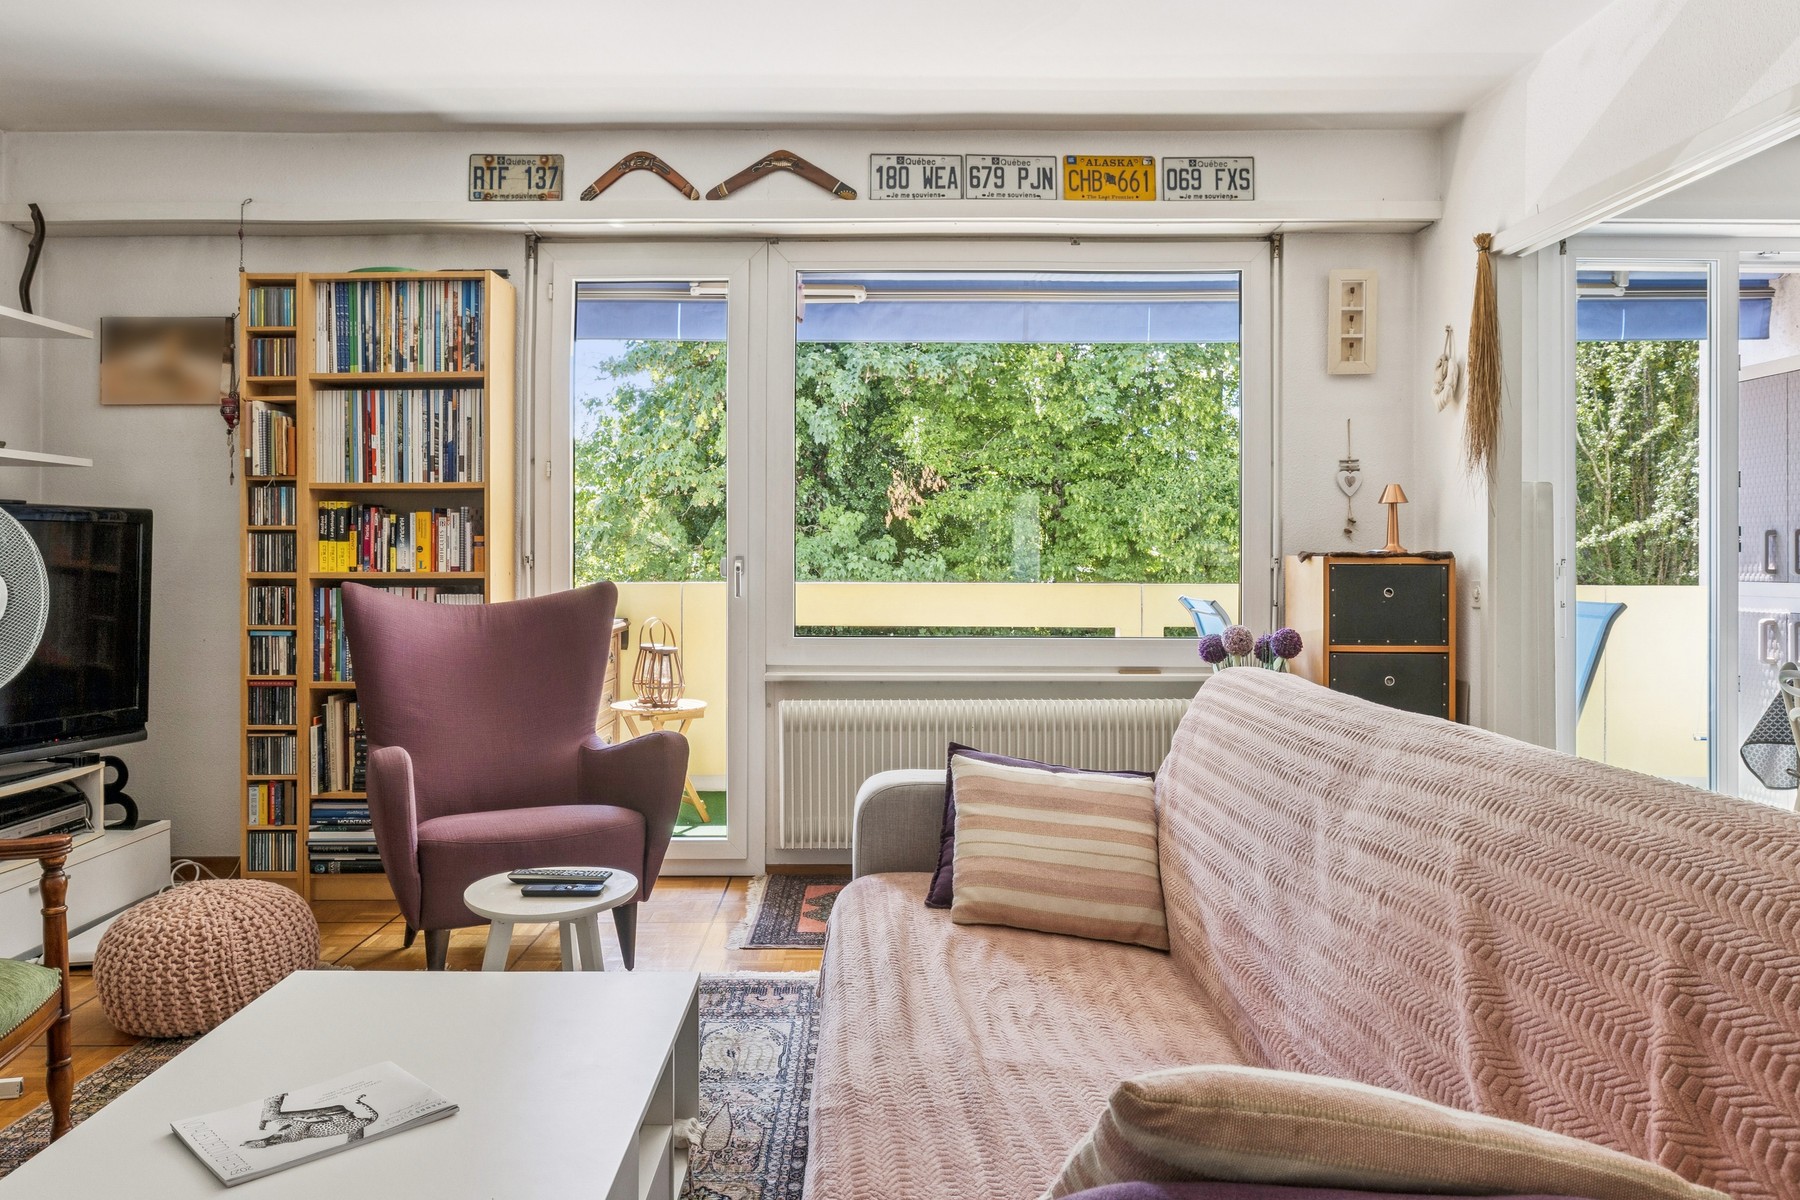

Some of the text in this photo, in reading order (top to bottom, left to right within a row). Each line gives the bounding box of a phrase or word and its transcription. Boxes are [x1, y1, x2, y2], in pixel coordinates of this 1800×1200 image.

[905, 157, 936, 166] Québec
[1000, 158, 1031, 167] Québec
[1085, 158, 1134, 167] ALASKA
[1197, 159, 1228, 168] Québec
[473, 166, 559, 190] RTF 137
[875, 165, 958, 190] 180 WEA
[969, 166, 1053, 190] 679 PJN
[1068, 169, 1149, 193] CHB 661
[1166, 168, 1250, 191] 069 FXS
